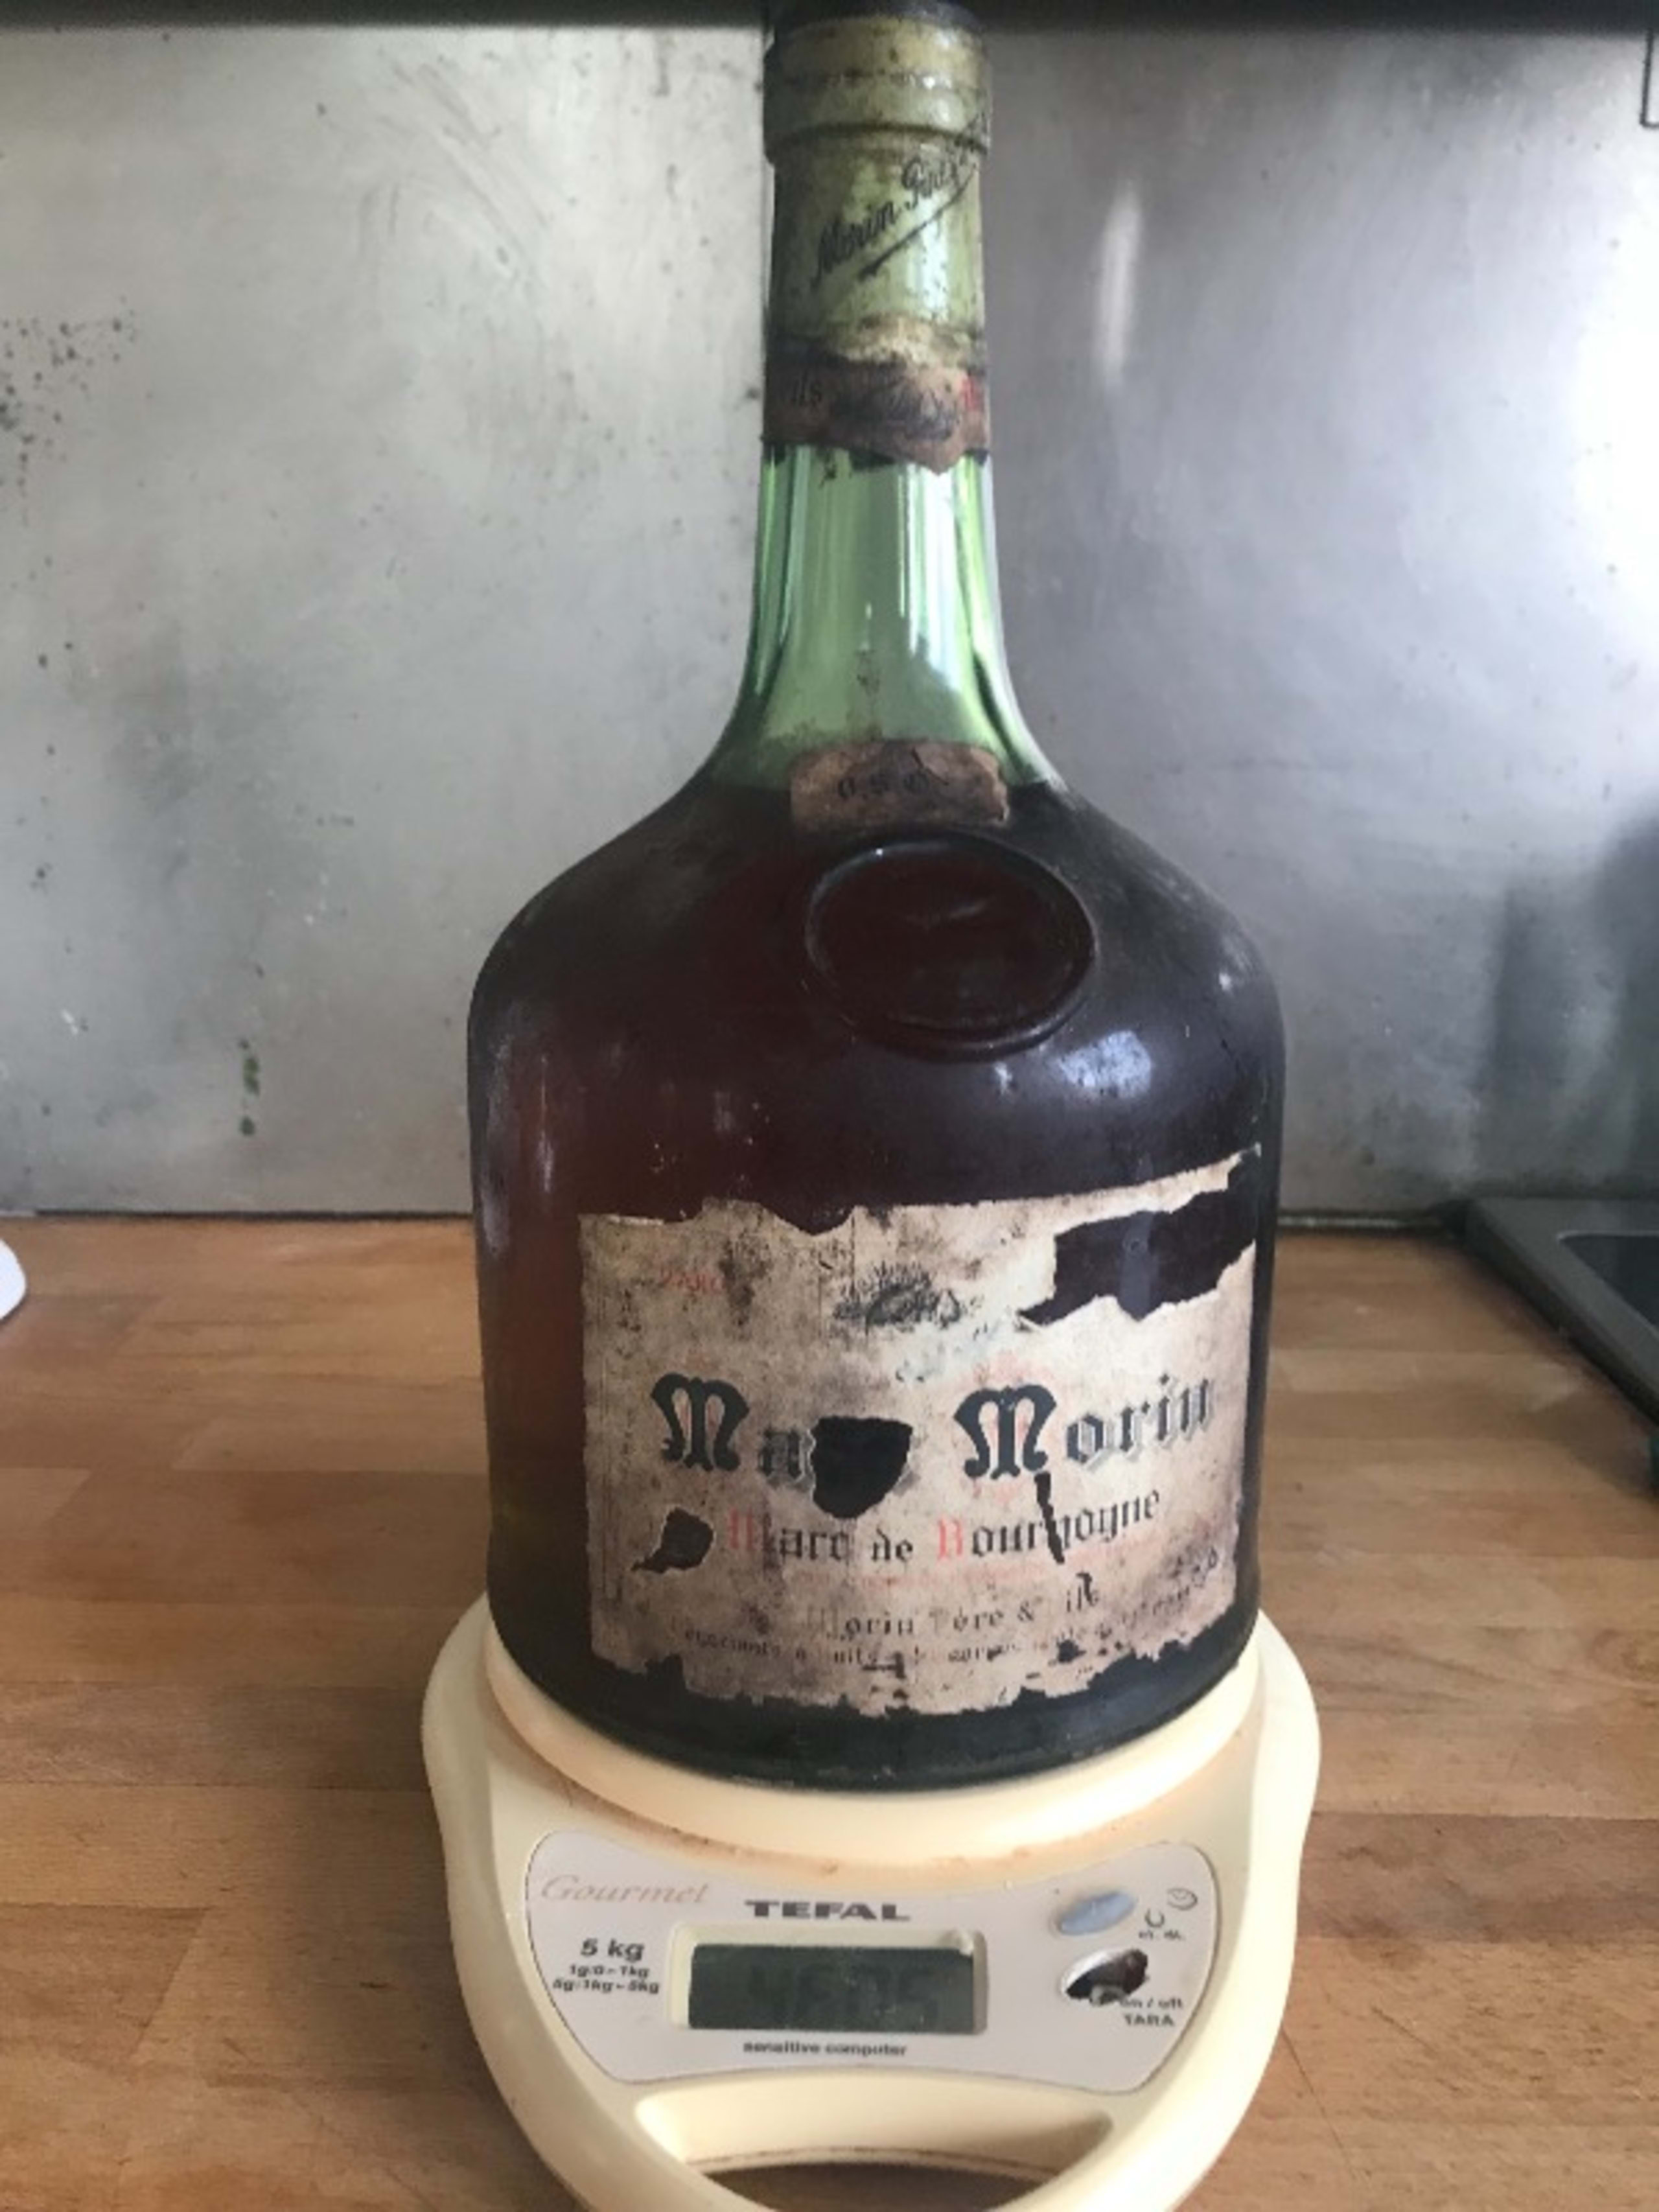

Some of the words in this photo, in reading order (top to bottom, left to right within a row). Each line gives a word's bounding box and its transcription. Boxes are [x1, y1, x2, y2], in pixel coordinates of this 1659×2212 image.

[953, 1373, 1216, 1480] Morin
[870, 1525, 914, 1563] de
[540, 1873, 709, 1903] Gourmet
[744, 1900, 911, 1921] TEFAL
[581, 1938, 599, 1957] 5
[607, 1938, 645, 1962] kg
[1122, 2013, 1176, 2027] TARA
[743, 2040, 820, 2055] sensitive
[824, 2042, 907, 2058] computer
